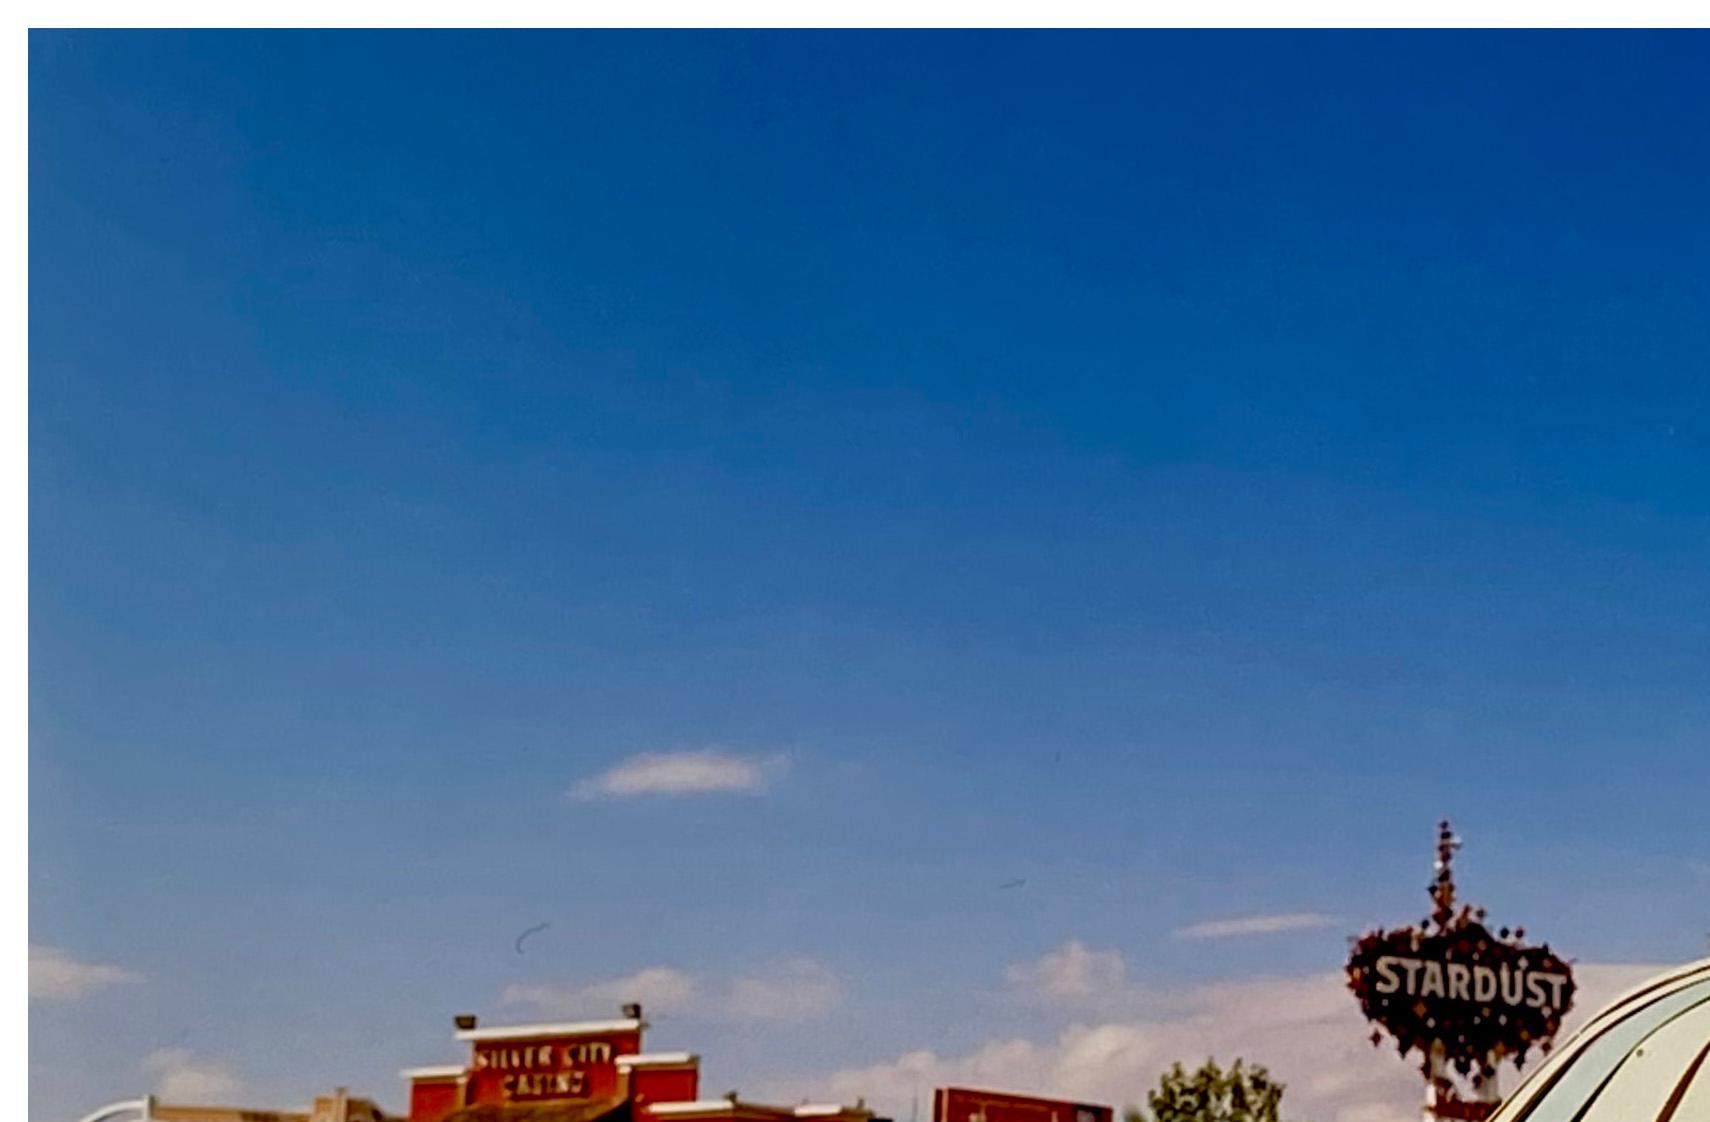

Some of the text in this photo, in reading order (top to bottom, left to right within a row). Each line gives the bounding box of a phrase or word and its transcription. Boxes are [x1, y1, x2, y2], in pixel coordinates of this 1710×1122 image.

[1375, 956, 1567, 1010] STARDUST
[475, 1041, 612, 1069] SILVER CITY
[502, 1071, 585, 1098] CASINO
